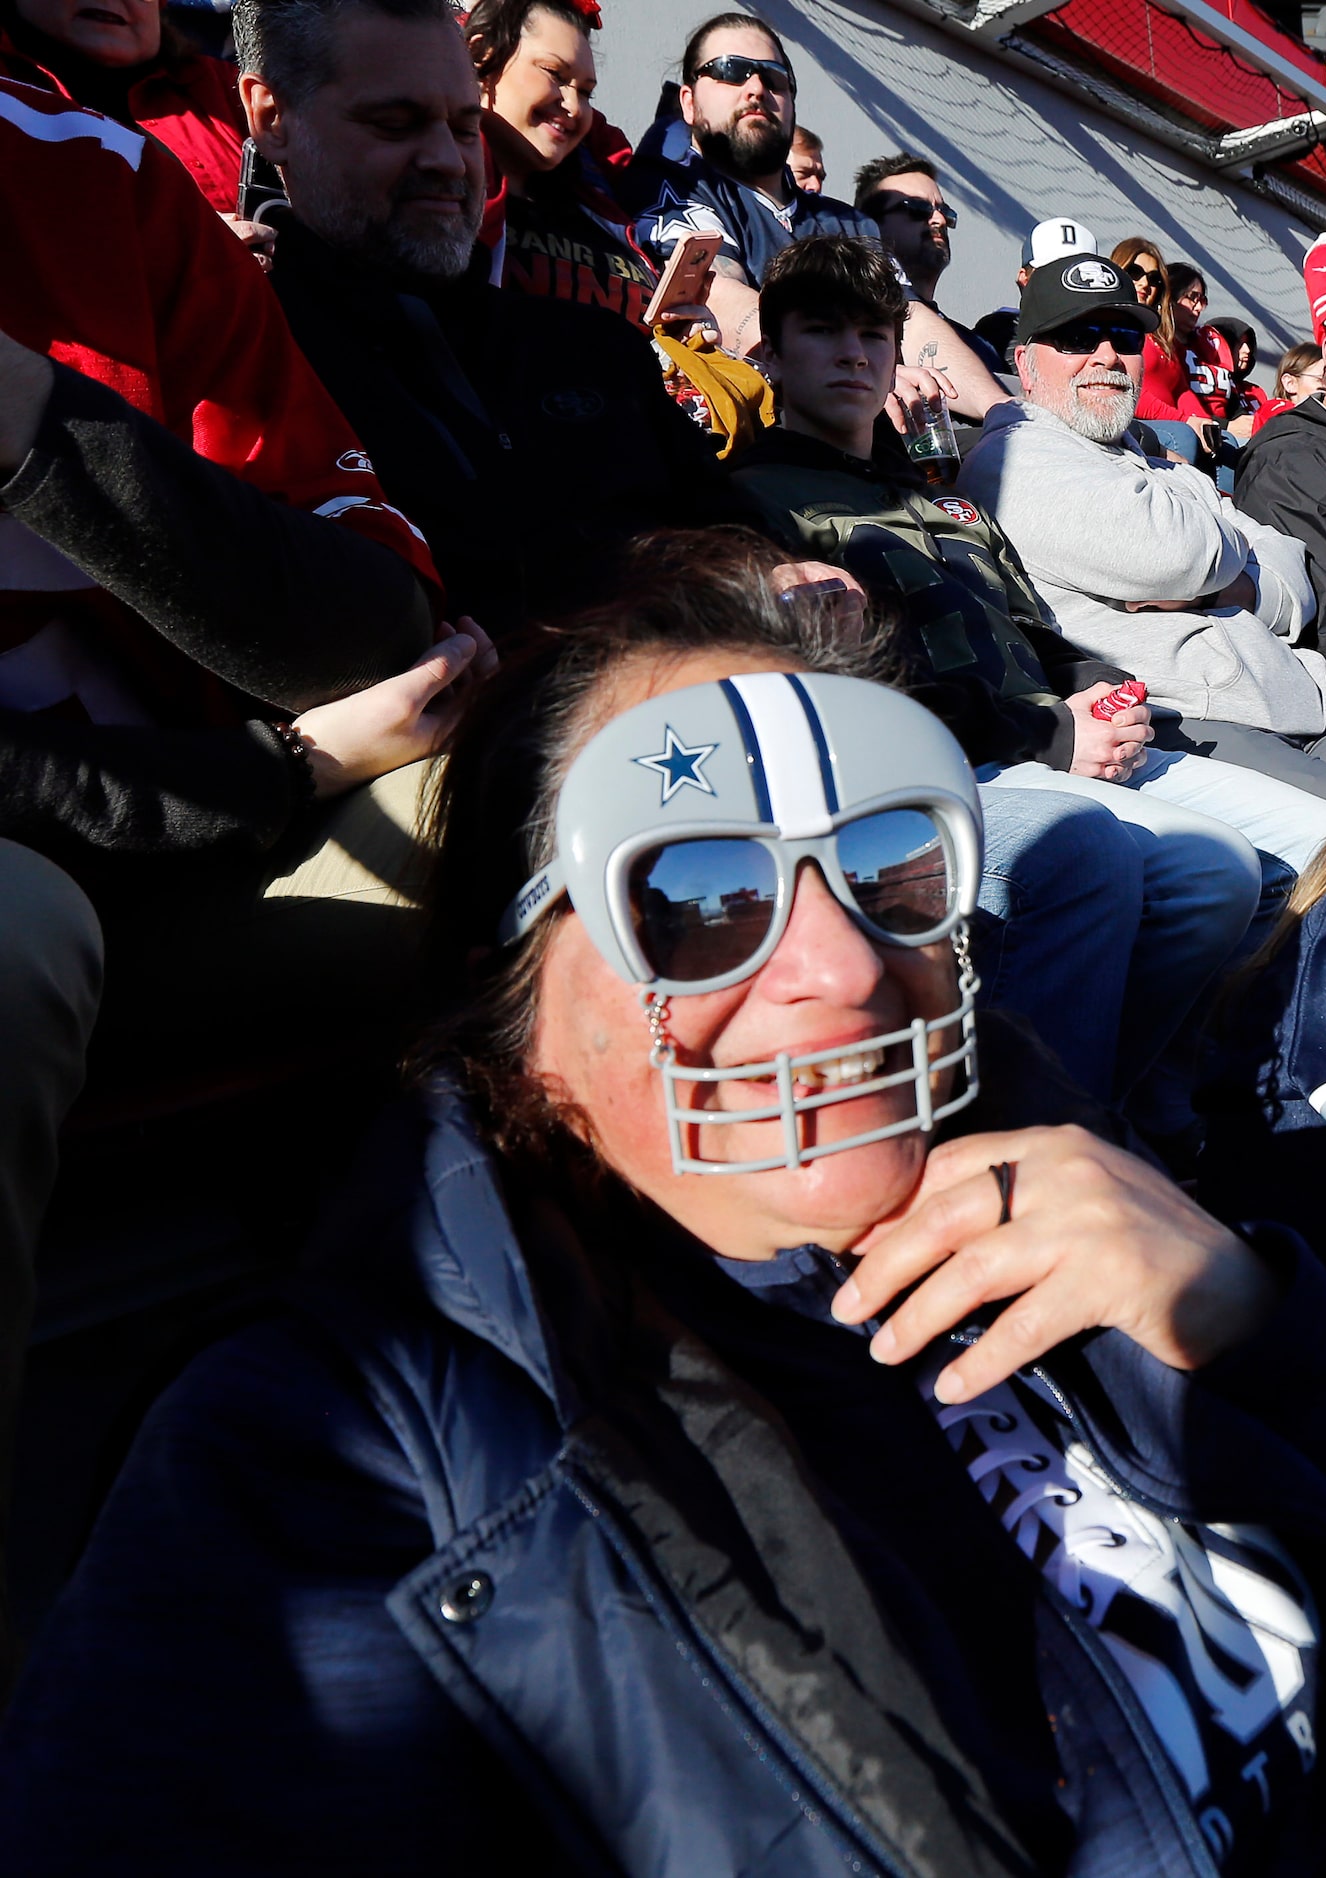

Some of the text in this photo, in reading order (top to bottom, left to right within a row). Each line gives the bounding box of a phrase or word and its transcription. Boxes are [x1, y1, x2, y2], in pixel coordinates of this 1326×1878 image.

[506, 224, 656, 291] BANG BA
[1061, 225, 1076, 245] D
[502, 252, 655, 336] NINE
[1185, 350, 1233, 400] 54
